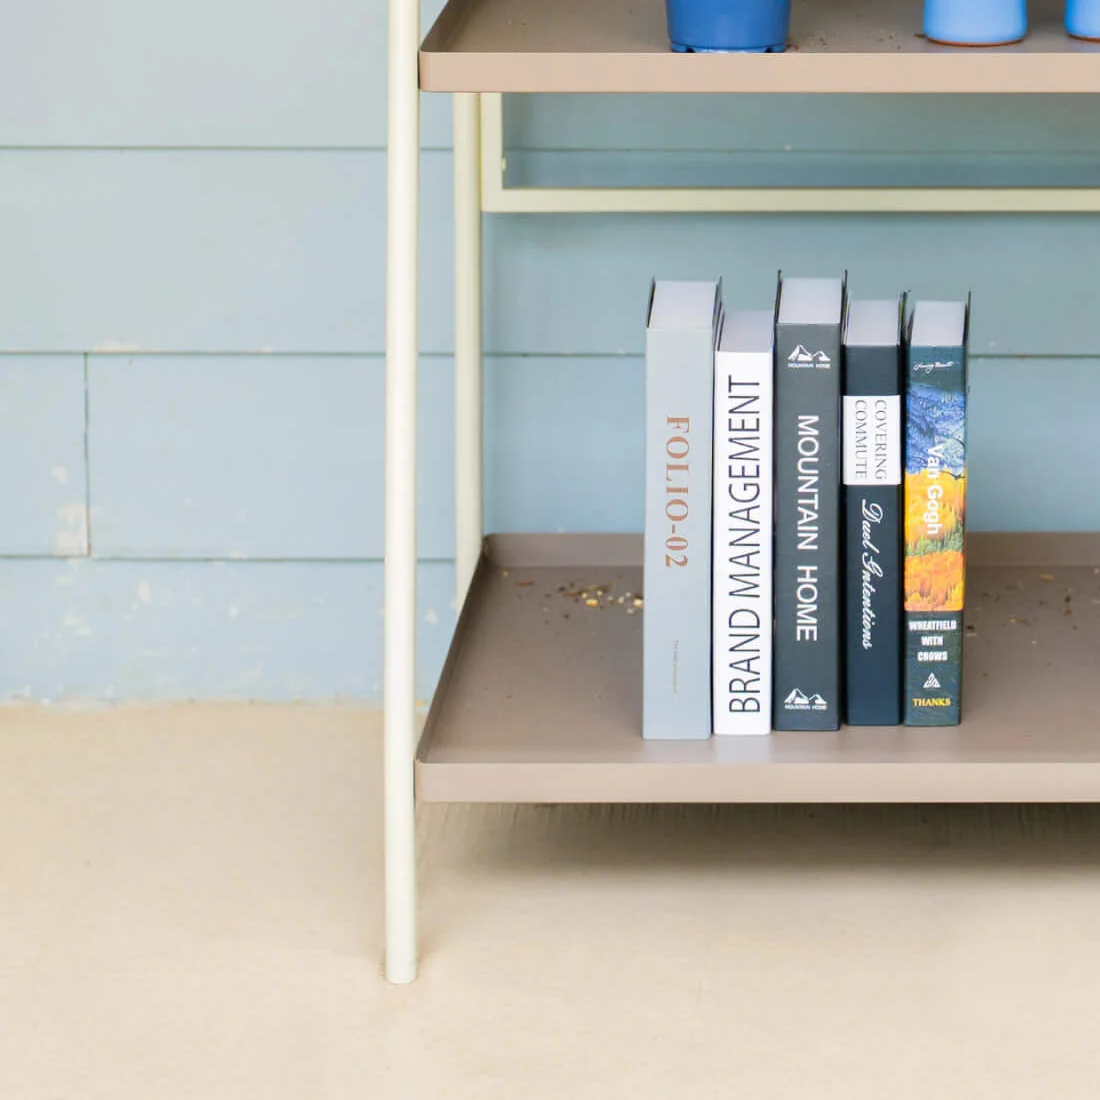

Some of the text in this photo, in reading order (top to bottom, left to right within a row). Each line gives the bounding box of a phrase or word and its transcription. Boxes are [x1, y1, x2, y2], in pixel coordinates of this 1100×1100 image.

[855, 400, 867, 479] COMMUTE
[875, 400, 887, 480] COVERING
[665, 415, 690, 568] FOLIO-02
[796, 415, 820, 642] MOUNTAIN HOME
[923, 443, 944, 534] Van Gogh
[728, 374, 760, 713] BRAND MANAGEMENT
[862, 552, 883, 649] Intentions
[908, 620, 957, 630] WHEATFIELD
[917, 651, 948, 661] CROWS
[921, 636, 944, 646] WITH
[913, 698, 951, 706] THANKS
